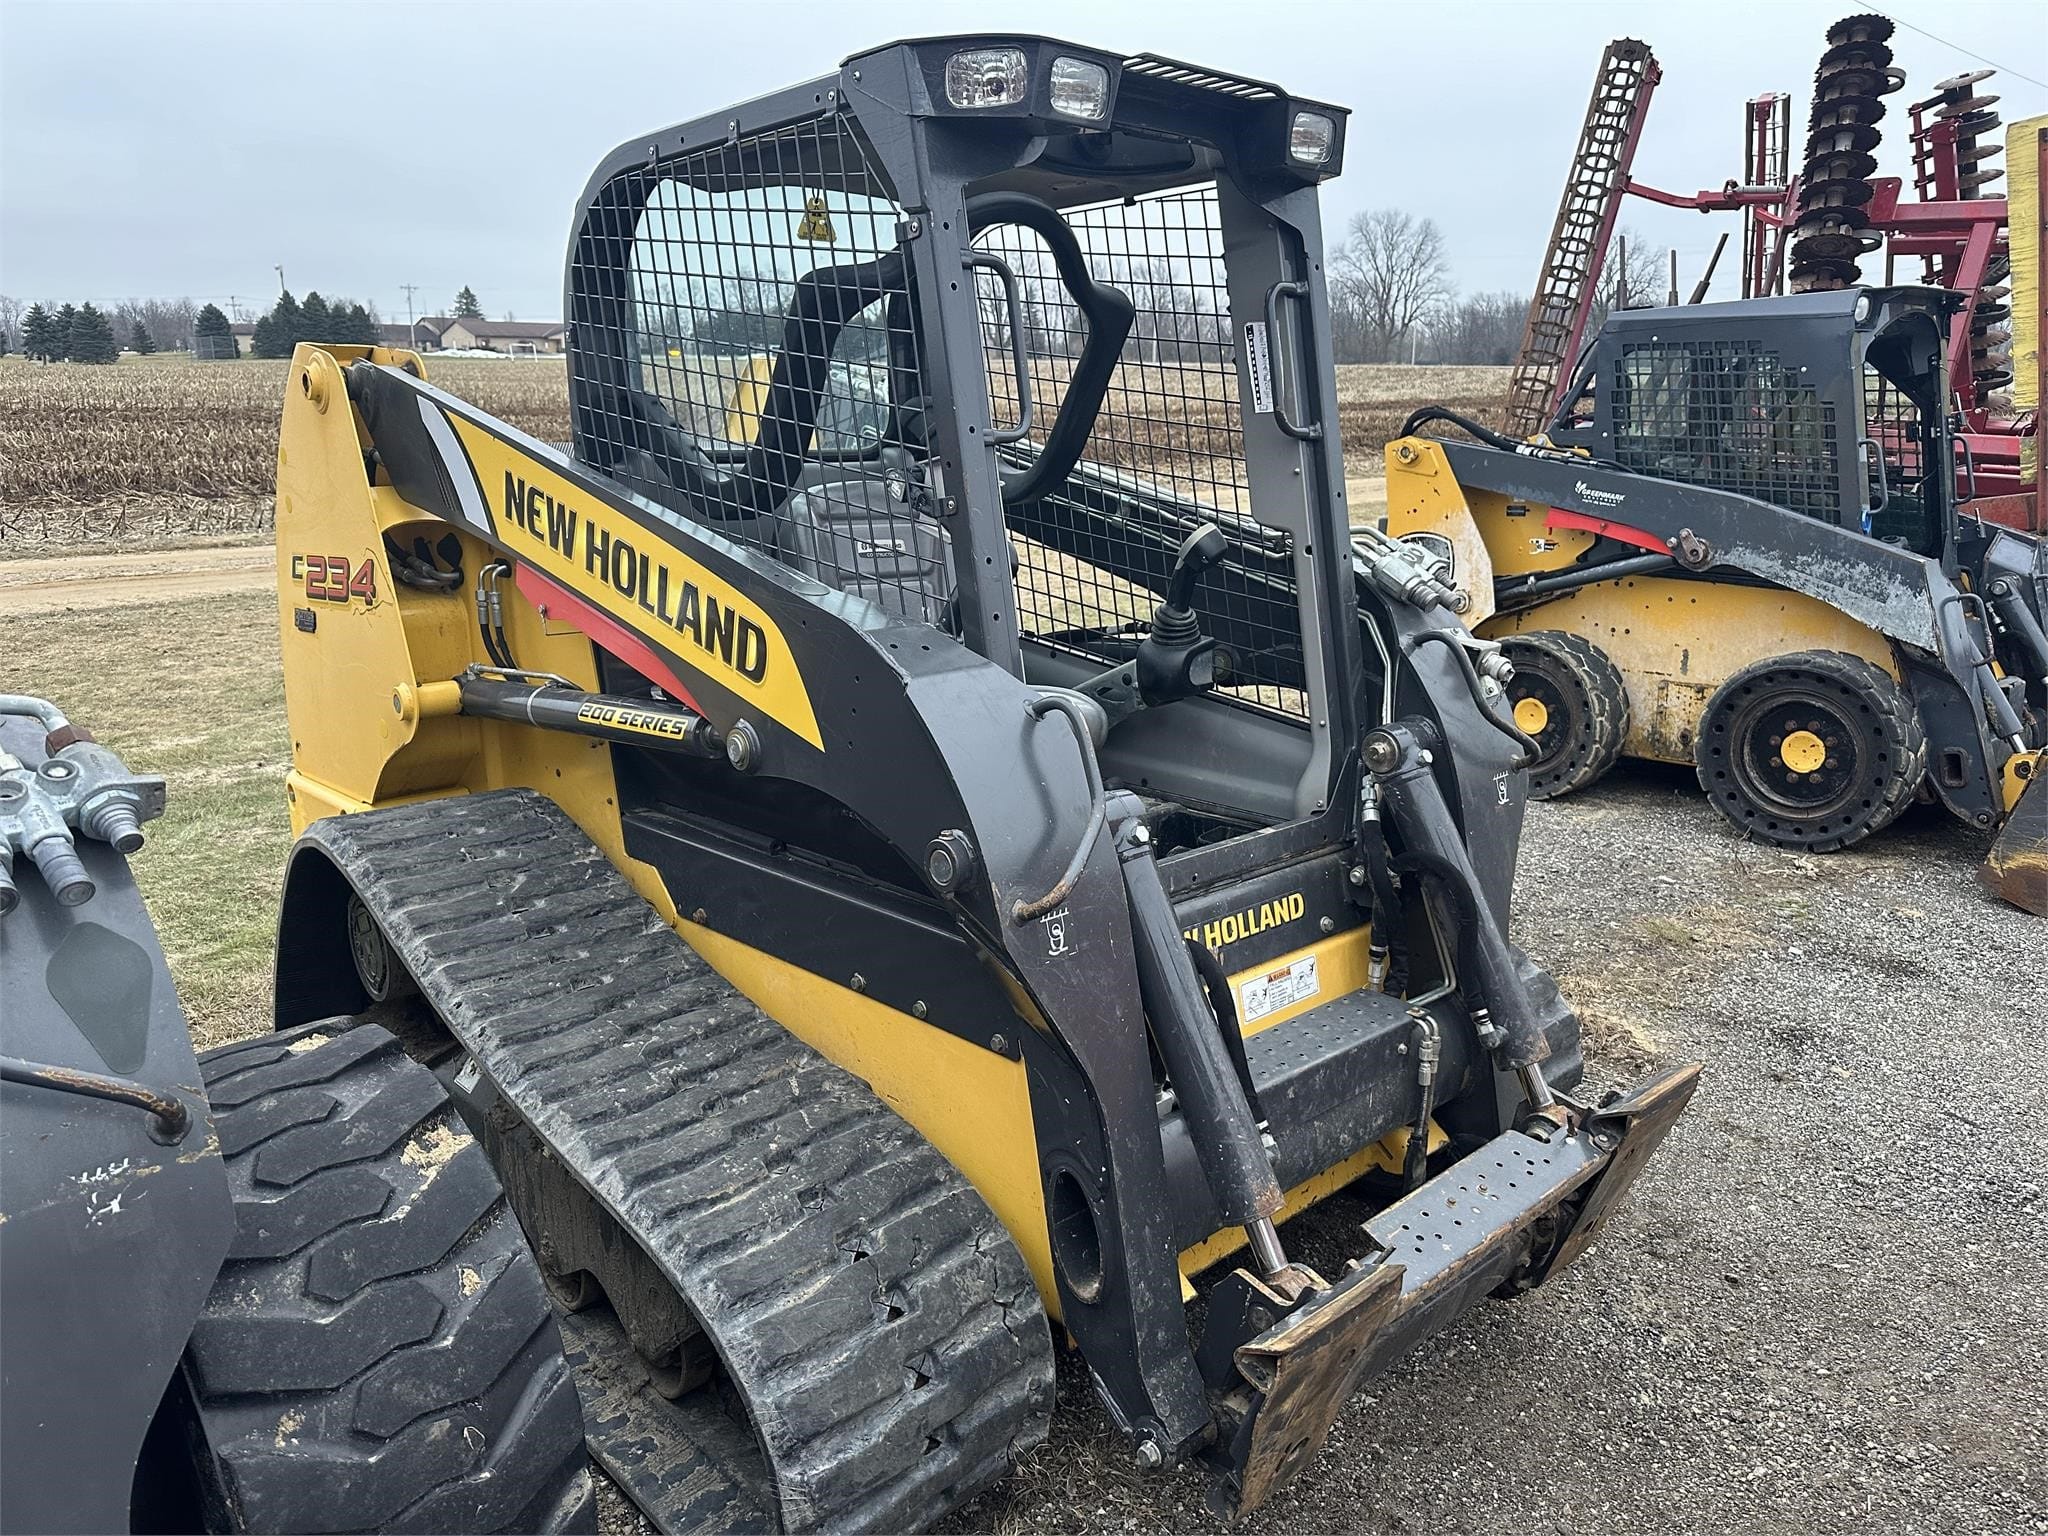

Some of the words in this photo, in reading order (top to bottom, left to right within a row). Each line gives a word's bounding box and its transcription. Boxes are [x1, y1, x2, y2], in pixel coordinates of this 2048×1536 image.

[1581, 489, 1626, 501] GREENMARK
[504, 469, 578, 562] NEW
[584, 519, 769, 685] HOLLAND
[579, 704, 617, 722] 200
[616, 711, 687, 736] SERIES
[1203, 892, 1305, 951] HOLLAND
